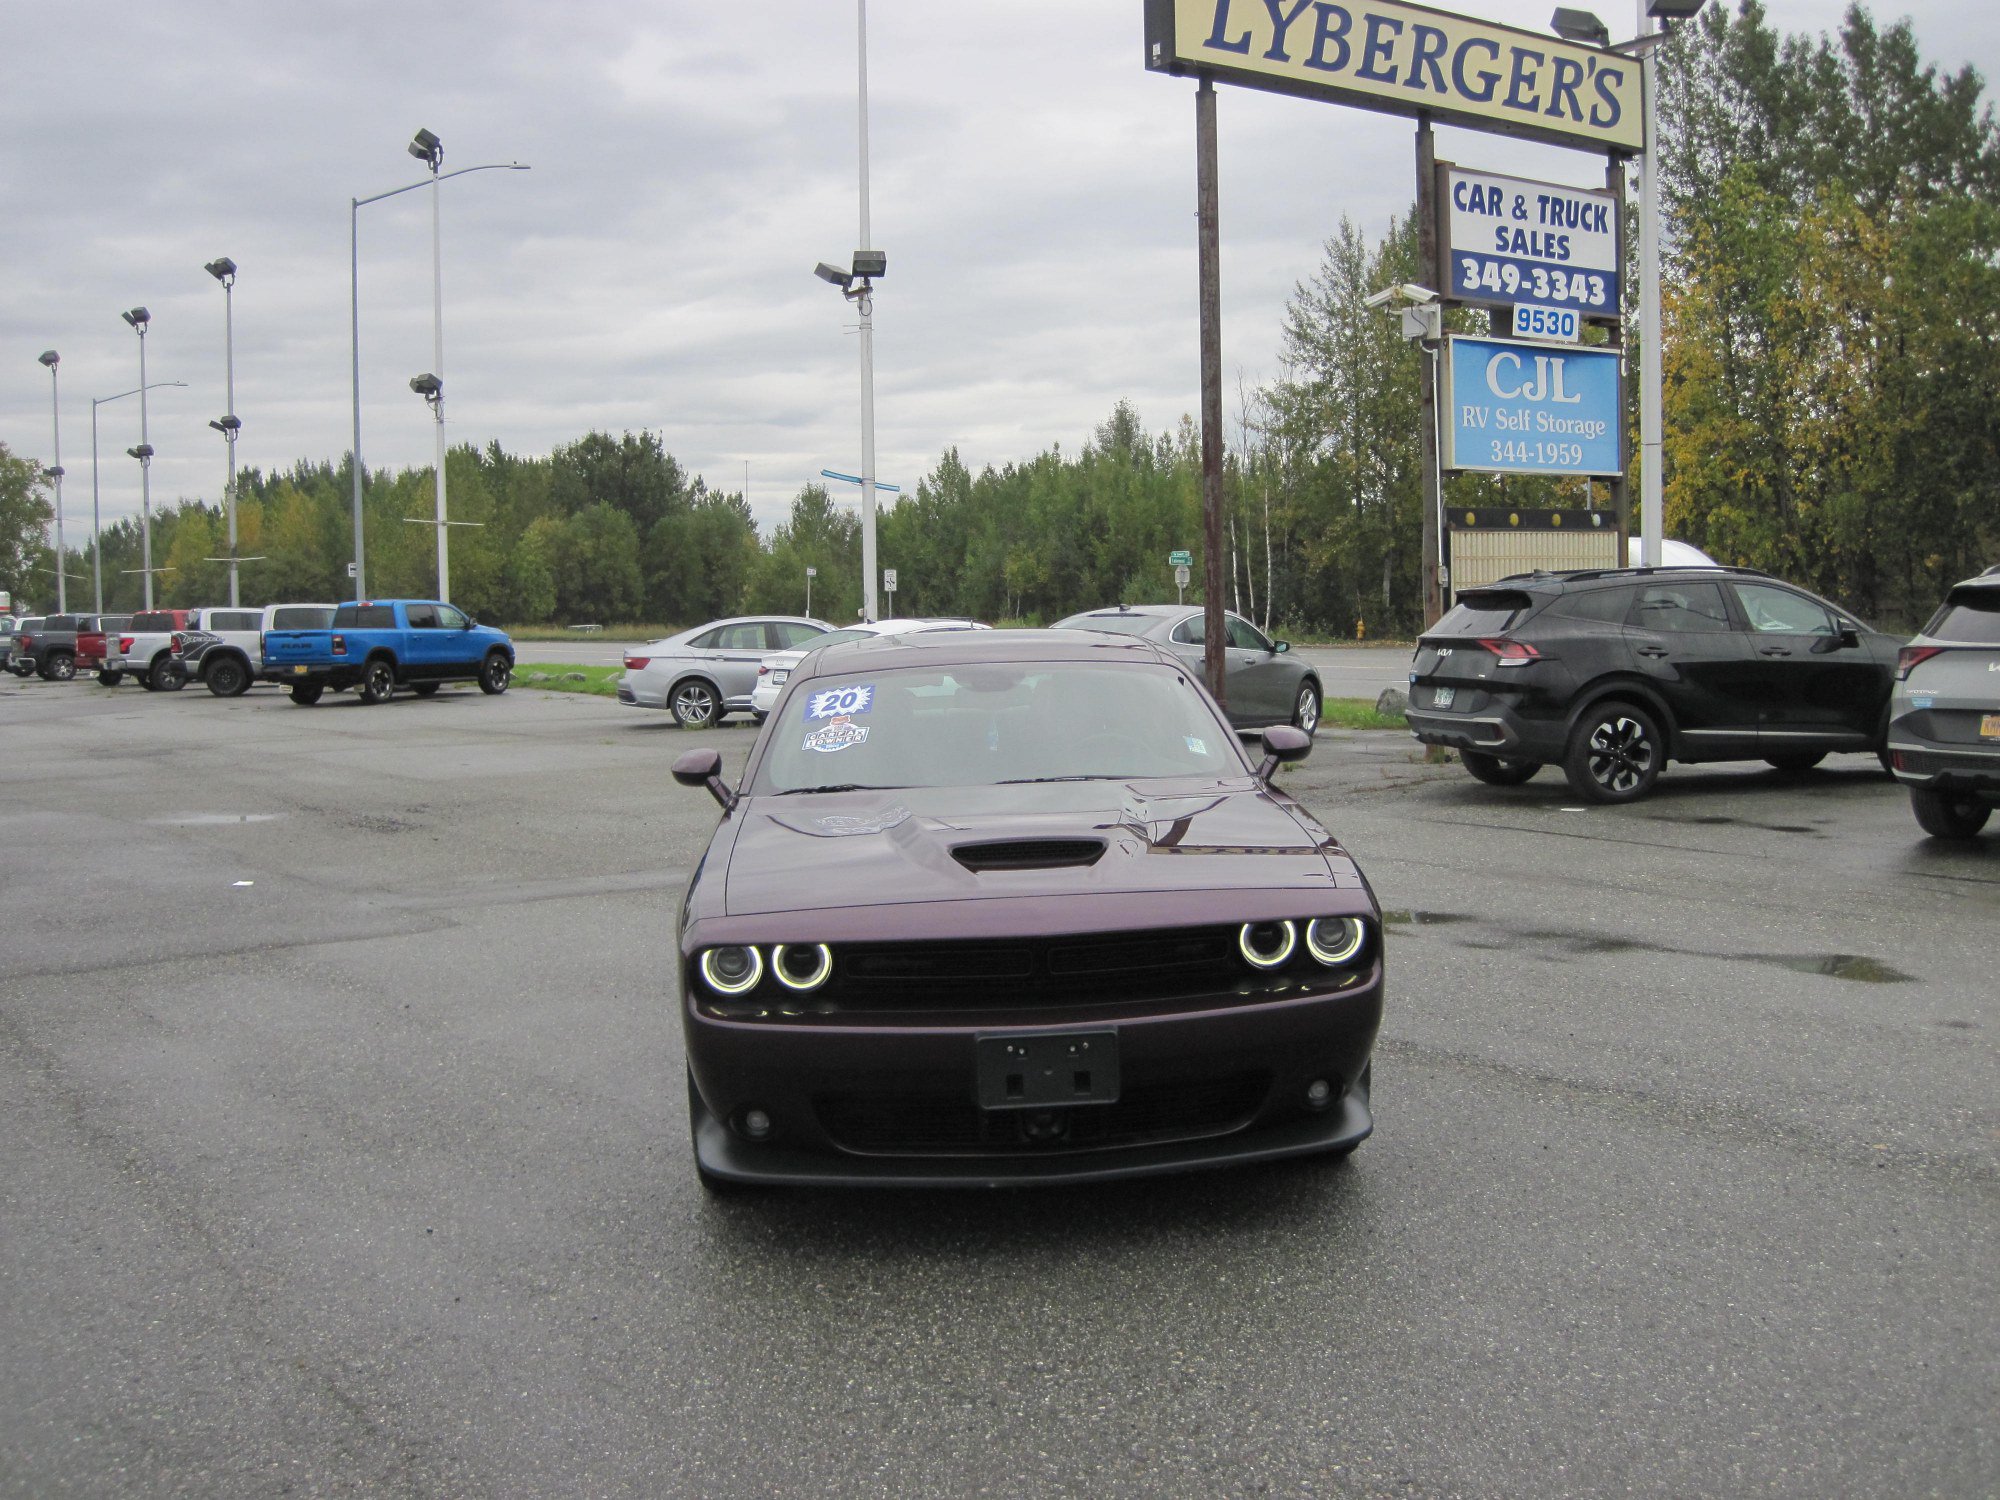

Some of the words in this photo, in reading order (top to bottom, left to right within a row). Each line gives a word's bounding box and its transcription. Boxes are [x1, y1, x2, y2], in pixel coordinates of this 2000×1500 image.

[1202, 0, 1624, 129] LYBERGER'S
[1453, 180, 1504, 218] CAR
[1511, 194, 1529, 221] &
[1537, 194, 1609, 234] TRUCK
[1495, 226, 1571, 261] SALES
[1461, 258, 1606, 306] 349-3343
[1517, 308, 1575, 337] 9530
[1485, 352, 1581, 403] CJL
[1462, 405, 1490, 429] RV
[1495, 408, 1531, 432] Self
[1536, 410, 1607, 440] Storage
[1490, 440, 1583, 465] 344-1959
[820, 691, 858, 712] 20
